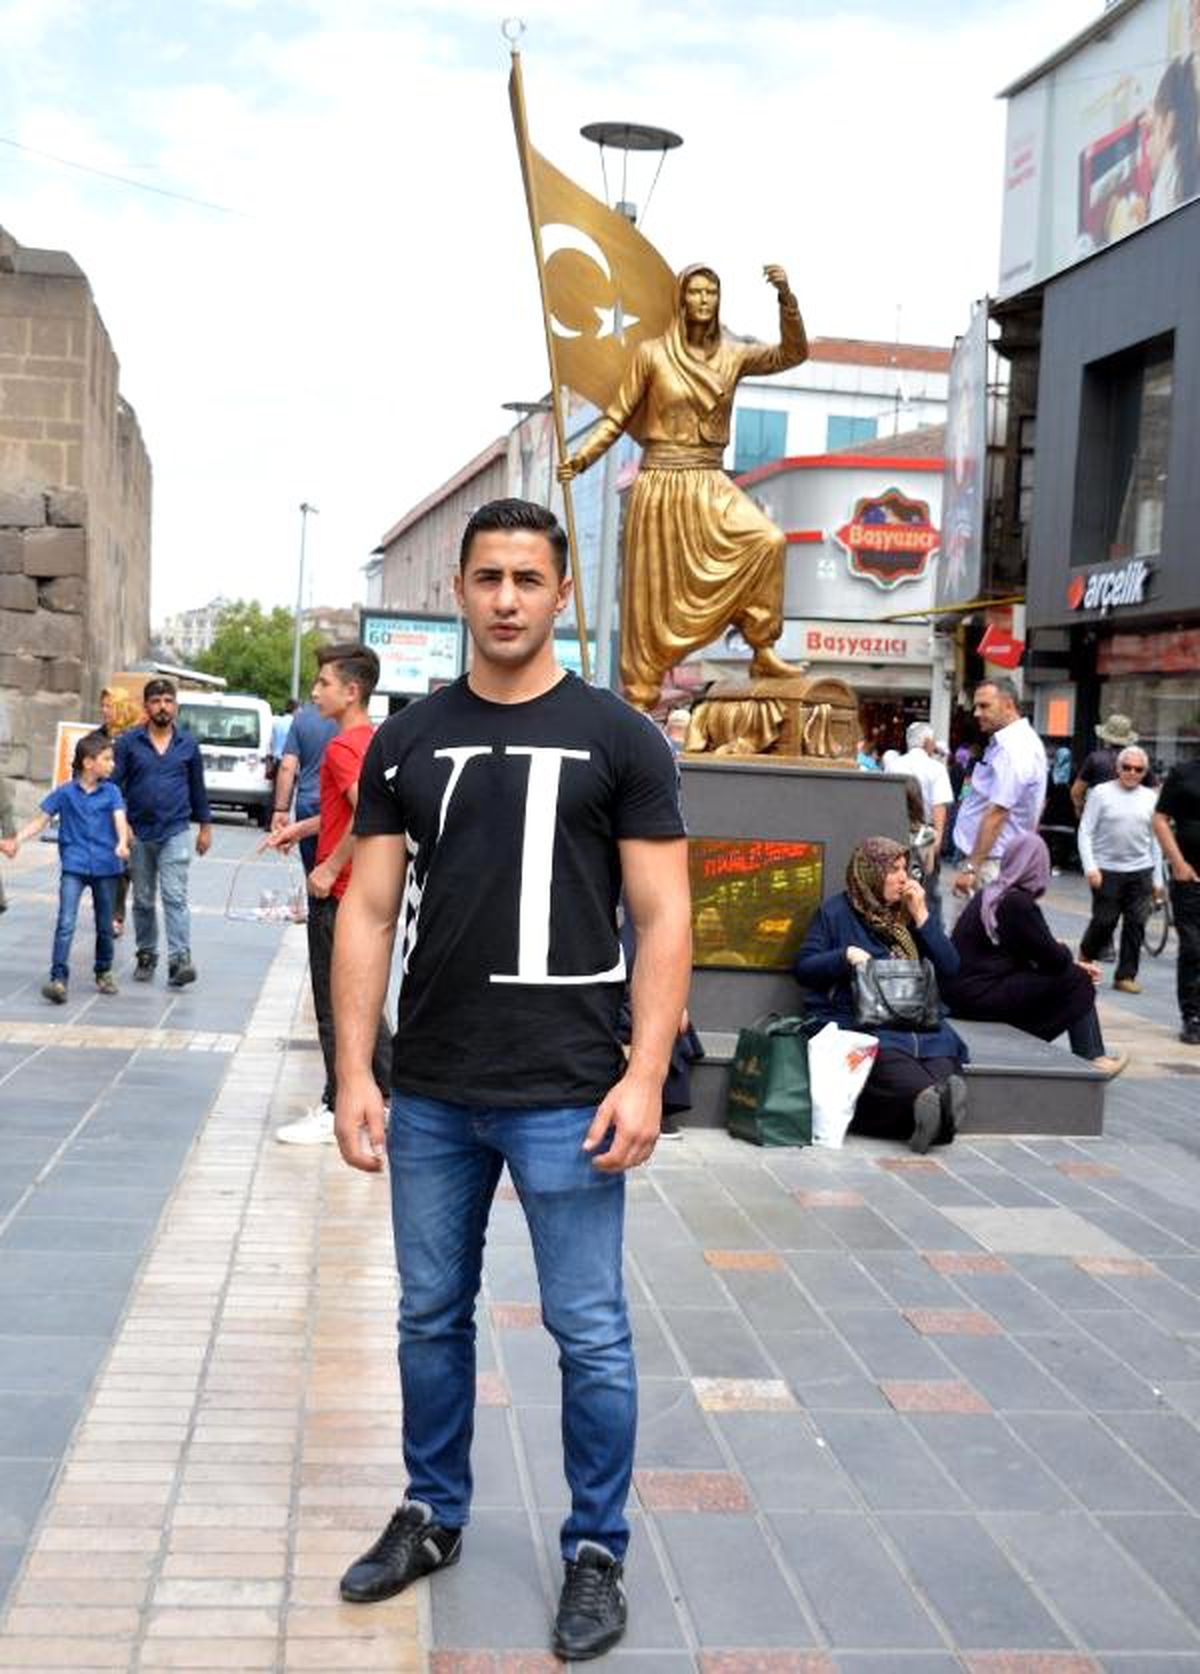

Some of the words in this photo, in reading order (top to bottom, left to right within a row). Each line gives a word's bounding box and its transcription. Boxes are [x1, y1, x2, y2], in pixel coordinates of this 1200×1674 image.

[850, 525, 931, 551] Başyazıcı
[1083, 560, 1148, 616] arçelik
[806, 631, 907, 656] Başyazıcı
